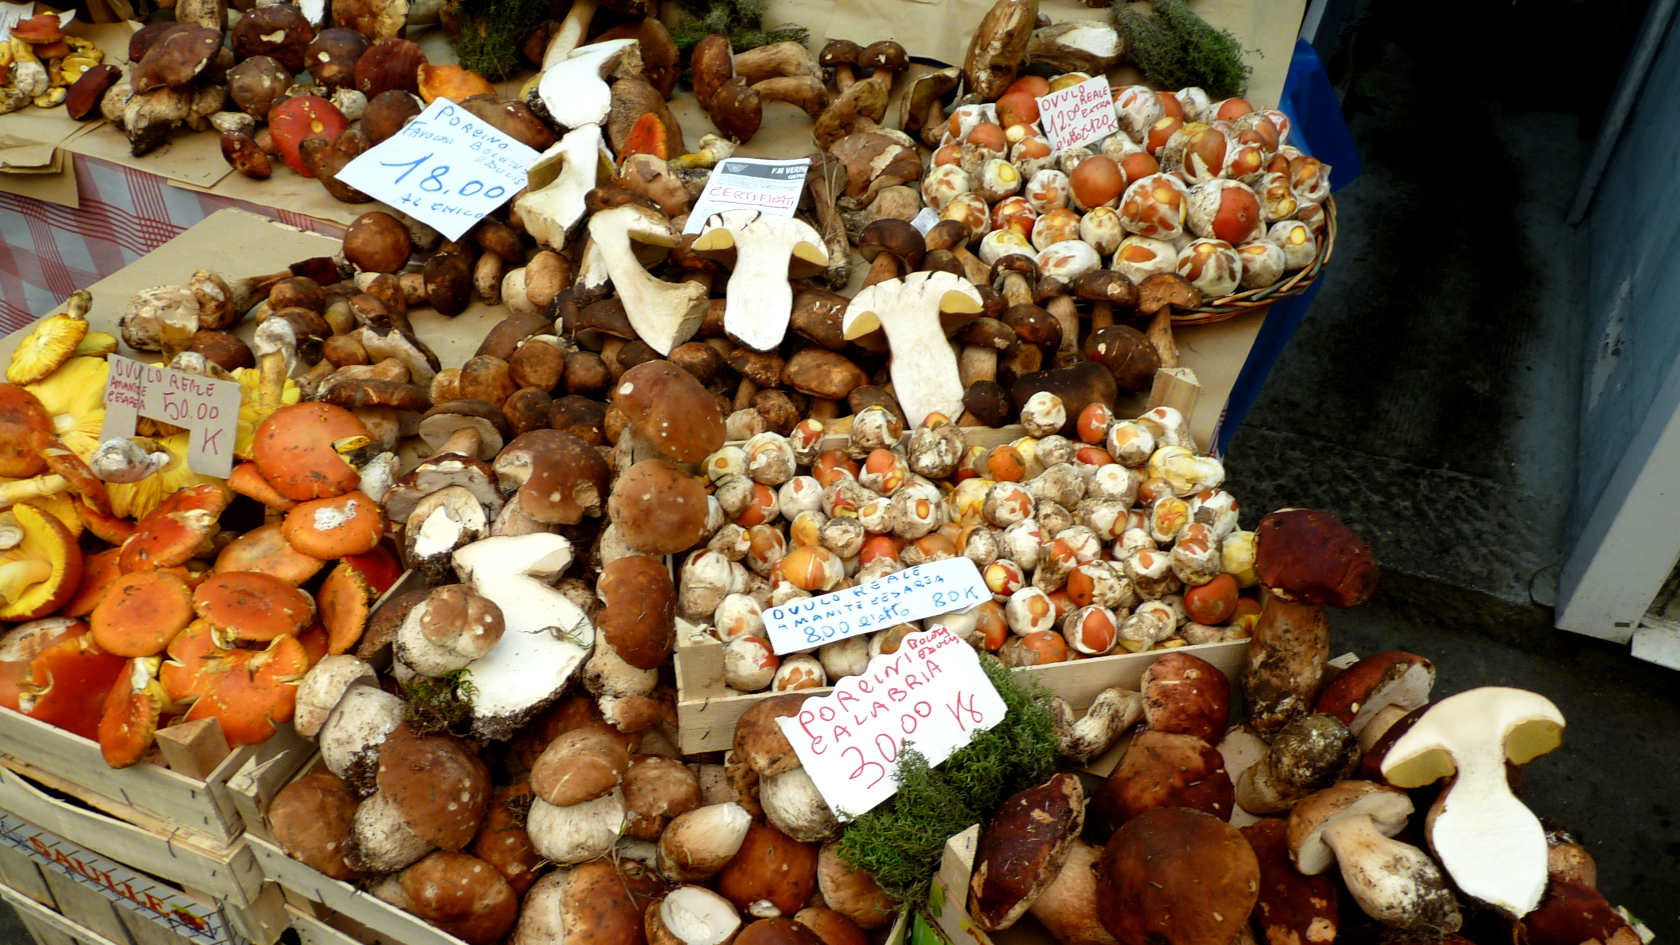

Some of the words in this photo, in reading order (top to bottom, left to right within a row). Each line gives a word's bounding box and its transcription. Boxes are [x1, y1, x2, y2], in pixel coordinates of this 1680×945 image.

[1041, 84, 1085, 111] OVULO
[1079, 86, 1108, 105] REALE
[1081, 100, 1111, 118] EXTRA
[393, 192, 420, 207] AL
[709, 186, 795, 206] CERTIFICATI
[116, 359, 163, 383] OVULO
[163, 392, 219, 420] 50.00
[202, 427, 223, 456] K
[773, 594, 840, 620] OVULO
[852, 565, 920, 597] REALE
[811, 659, 943, 755] CALABRIA
